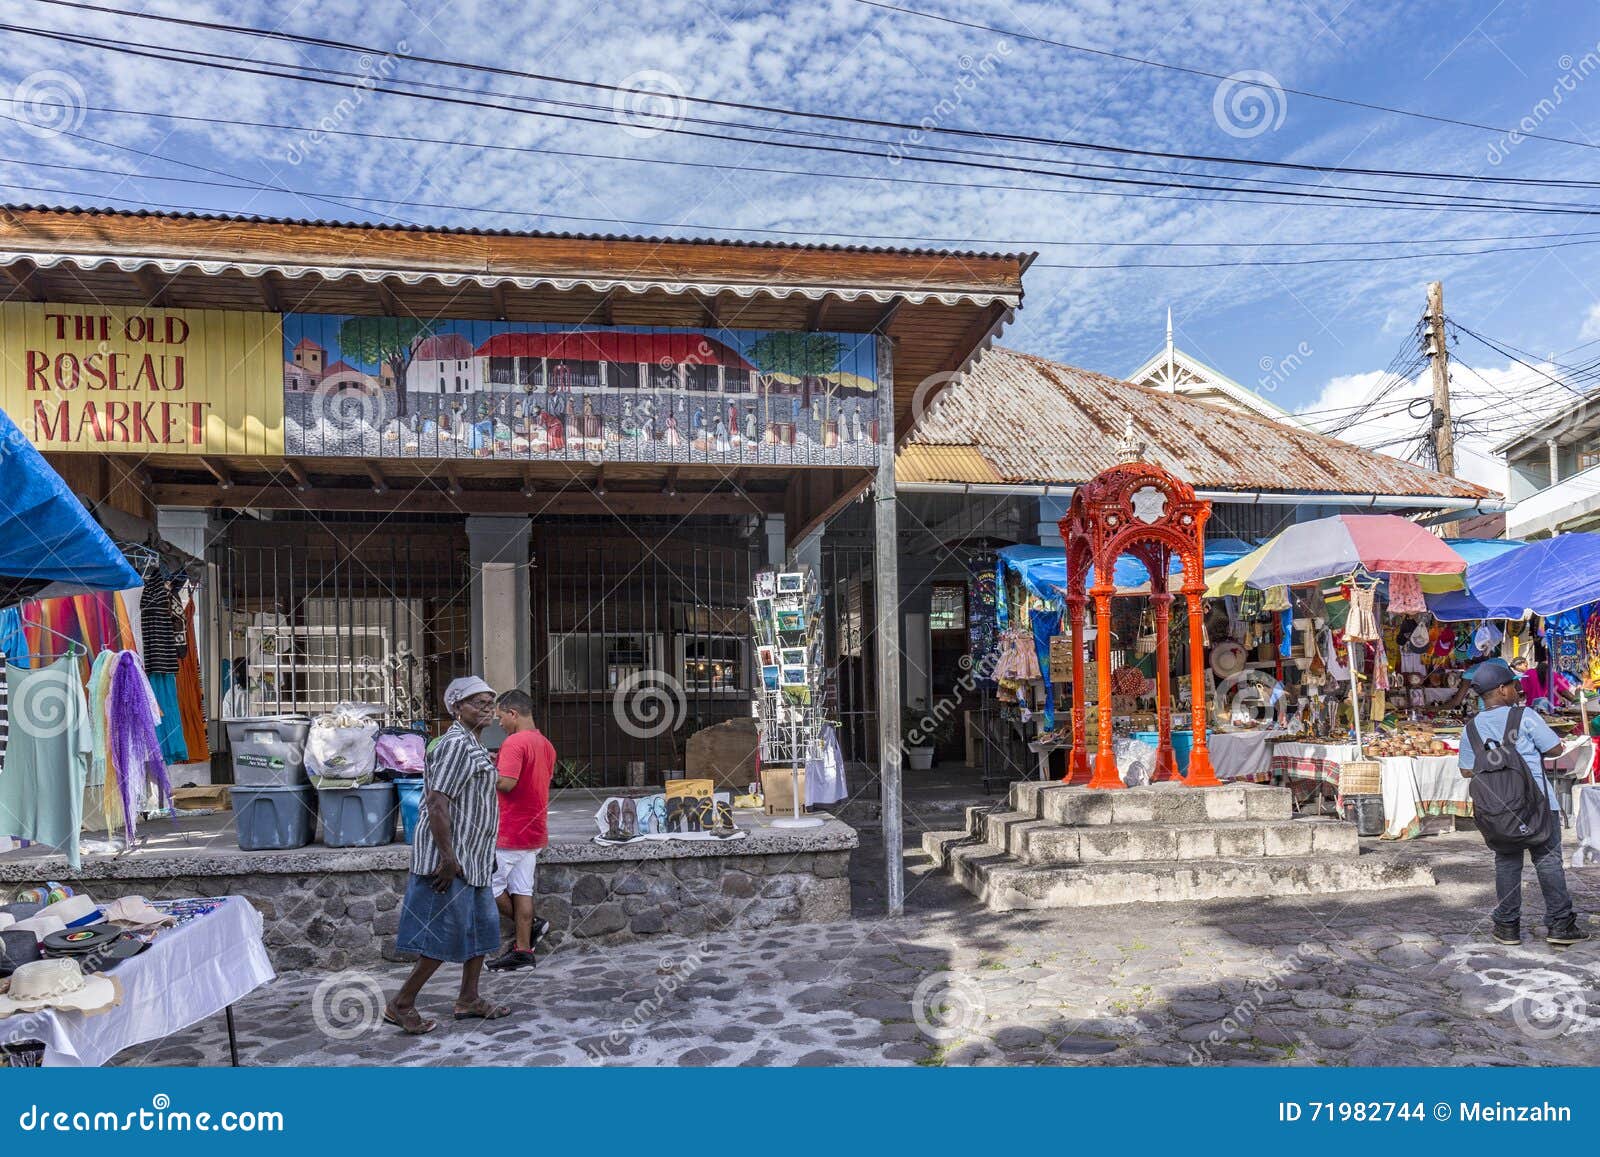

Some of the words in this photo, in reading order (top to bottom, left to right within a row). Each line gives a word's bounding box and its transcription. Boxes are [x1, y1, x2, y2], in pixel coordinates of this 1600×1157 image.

[45, 313, 112, 341] THE
[124, 314, 190, 345] OLD
[26, 350, 185, 391] ROSEAU
[33, 399, 212, 446] MARKET
